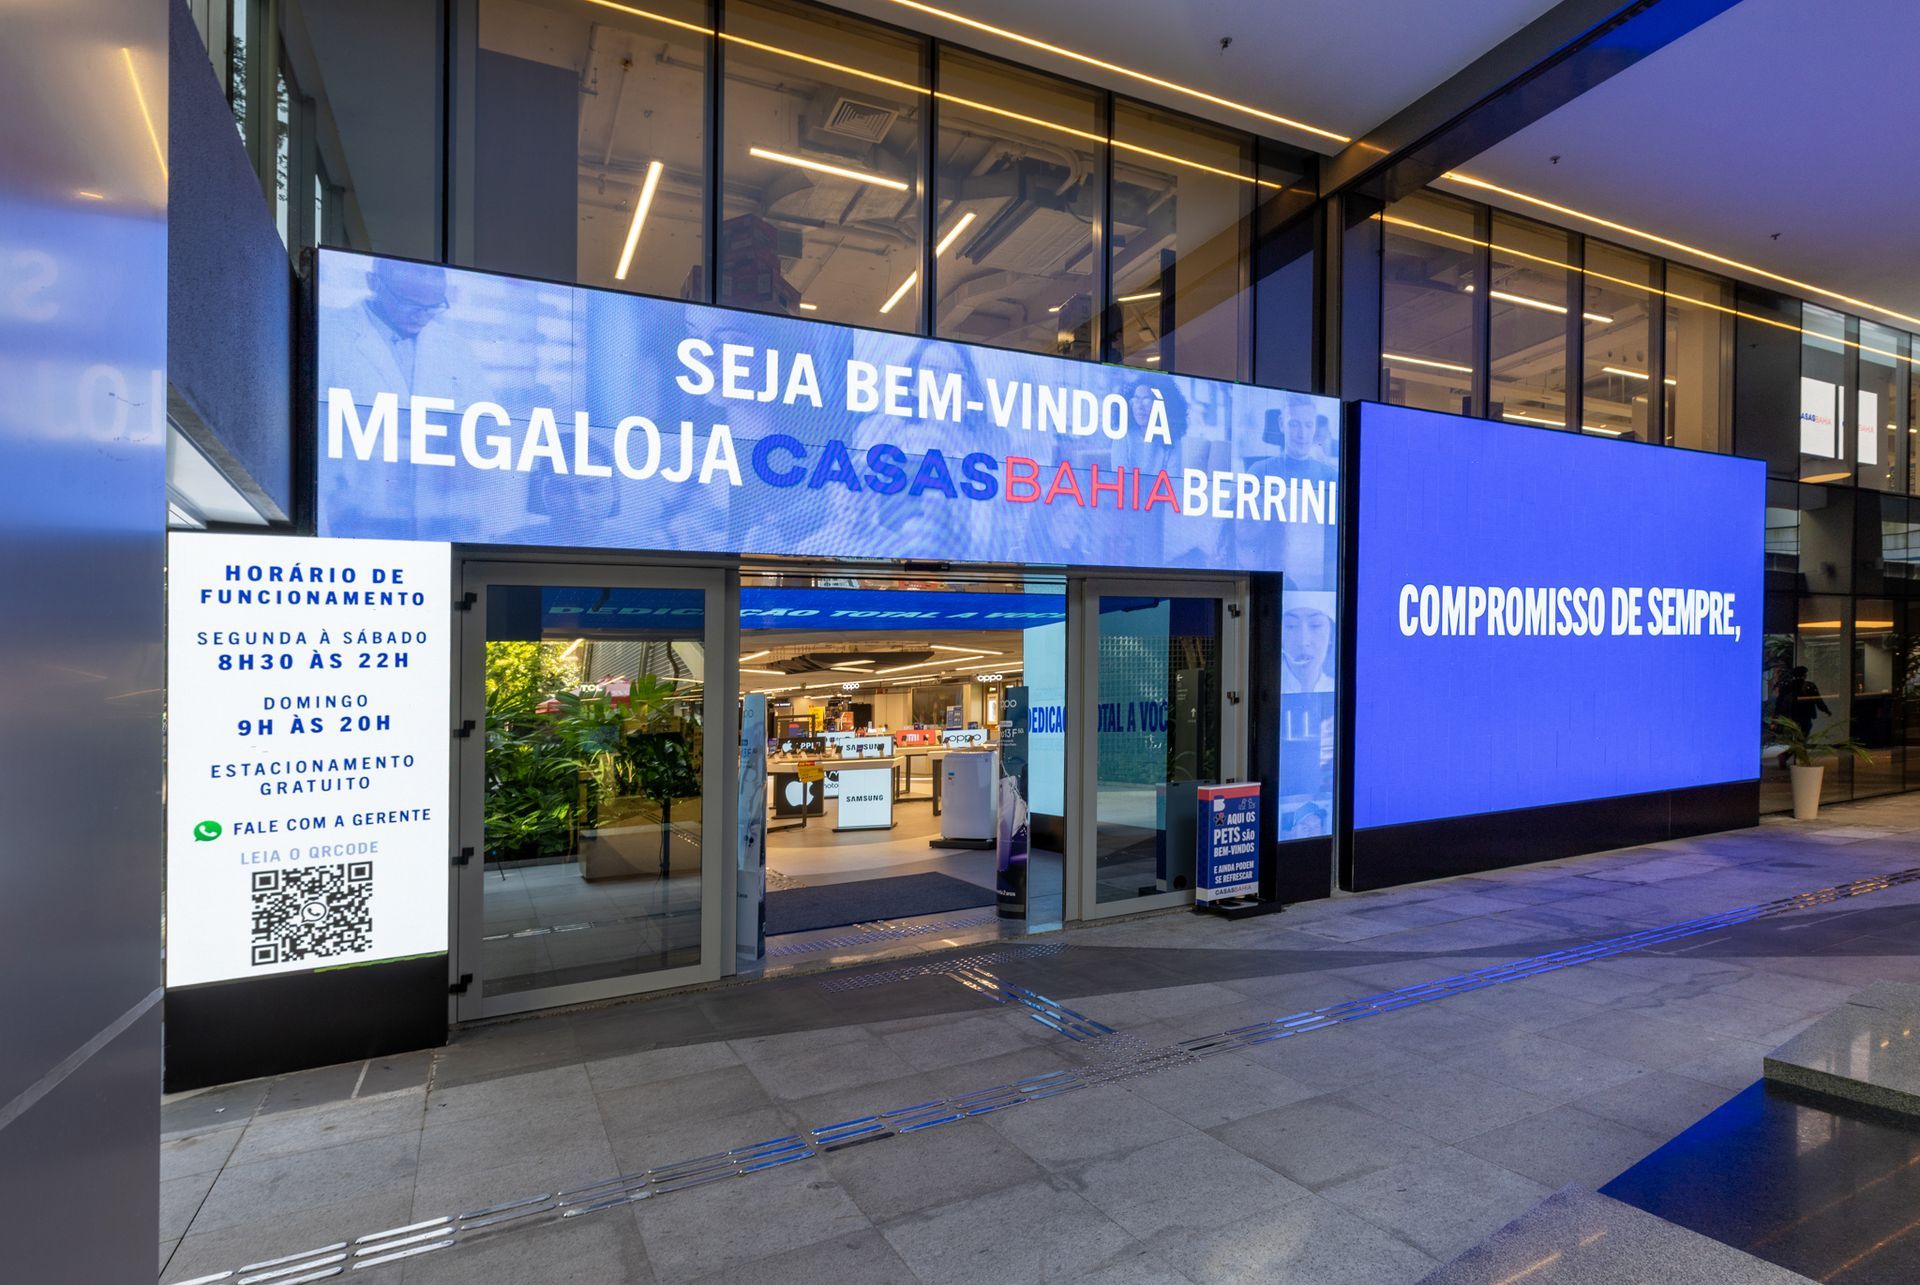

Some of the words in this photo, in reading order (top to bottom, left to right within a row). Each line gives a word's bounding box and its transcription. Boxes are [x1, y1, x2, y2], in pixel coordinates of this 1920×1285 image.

[676, 338, 823, 408] SEJA
[846, 360, 1129, 440] BEM-VINDO
[1144, 388, 1172, 444] À
[328, 387, 742, 486] MEGALOJA
[1183, 468, 1336, 525] BERRINI
[225, 563, 356, 584] HORÁRIO
[372, 568, 404, 584] DE
[200, 589, 425, 606] FUNCIONAMENTO
[1399, 583, 1605, 637] COMPROMISSO
[1611, 587, 1643, 636] DE
[1647, 587, 1741, 642] SEMPRE,
[197, 631, 307, 645] SEGUNDA
[319, 629, 331, 645] À
[343, 628, 427, 645] SÁBADO
[218, 653, 293, 671] 8H30
[309, 650, 343, 669] ÀS
[358, 652, 408, 669] 22H
[264, 694, 368, 710] DOMINGO
[238, 719, 273, 736] 9H
[290, 714, 323, 734] ÀS
[340, 715, 390, 732] 20H
[1127, 702, 1136, 733] A
[1139, 700, 1168, 732] VOC
[846, 743, 884, 752] SASUN
[211, 755, 414, 778] ESTACIONAMENTO
[260, 776, 370, 796] GRATUITO
[846, 794, 884, 802] SAMSUNG
[233, 819, 279, 836] FALE
[287, 815, 326, 832] COM
[334, 815, 345, 828] A
[352, 808, 431, 826] GERENTE
[1227, 813, 1244, 825] AQUI
[1246, 811, 1256, 823] OS
[1213, 827, 1241, 846] PETS
[240, 849, 281, 865] LEIA
[290, 848, 300, 861] O
[309, 841, 379, 860] QRCODE
[1213, 842, 1255, 858] BEM-VINDOS
[1213, 865, 1218, 874] E
[1219, 862, 1235, 873] AINDA
[1235, 860, 1255, 871] PODEM
[1215, 875, 1223, 884] SE
[1223, 871, 1253, 883] REFRESCAR
